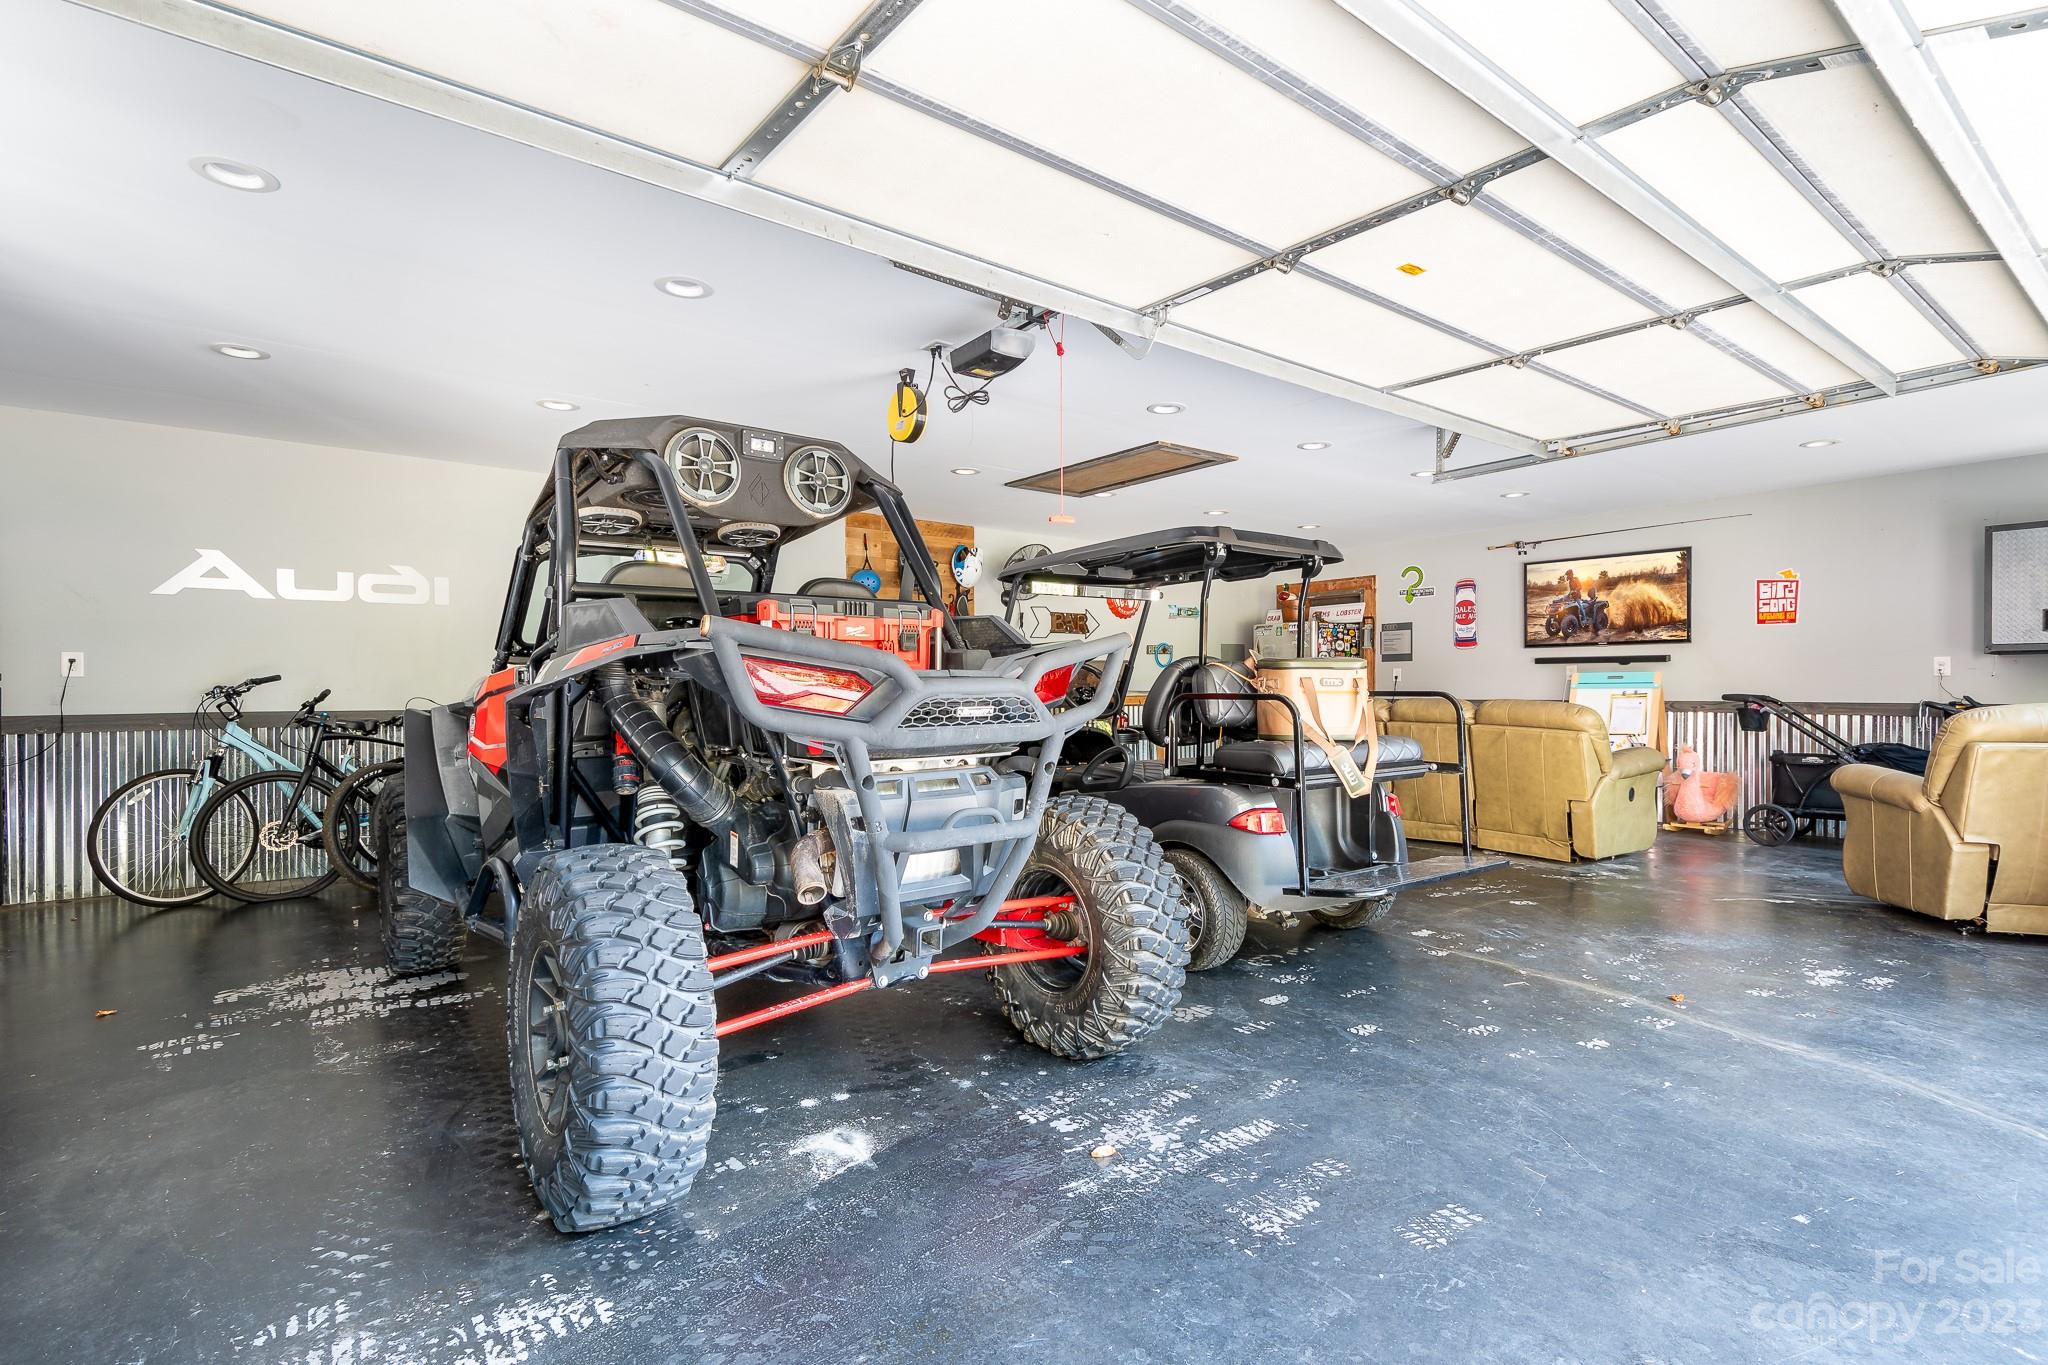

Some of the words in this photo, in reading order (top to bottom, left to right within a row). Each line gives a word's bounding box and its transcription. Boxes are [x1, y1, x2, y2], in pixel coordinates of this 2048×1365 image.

[149, 548, 449, 606] Audi
[1052, 612, 1090, 633] BAR
[1312, 610, 1330, 618] CMS
[1336, 608, 1362, 617] LOBSTER
